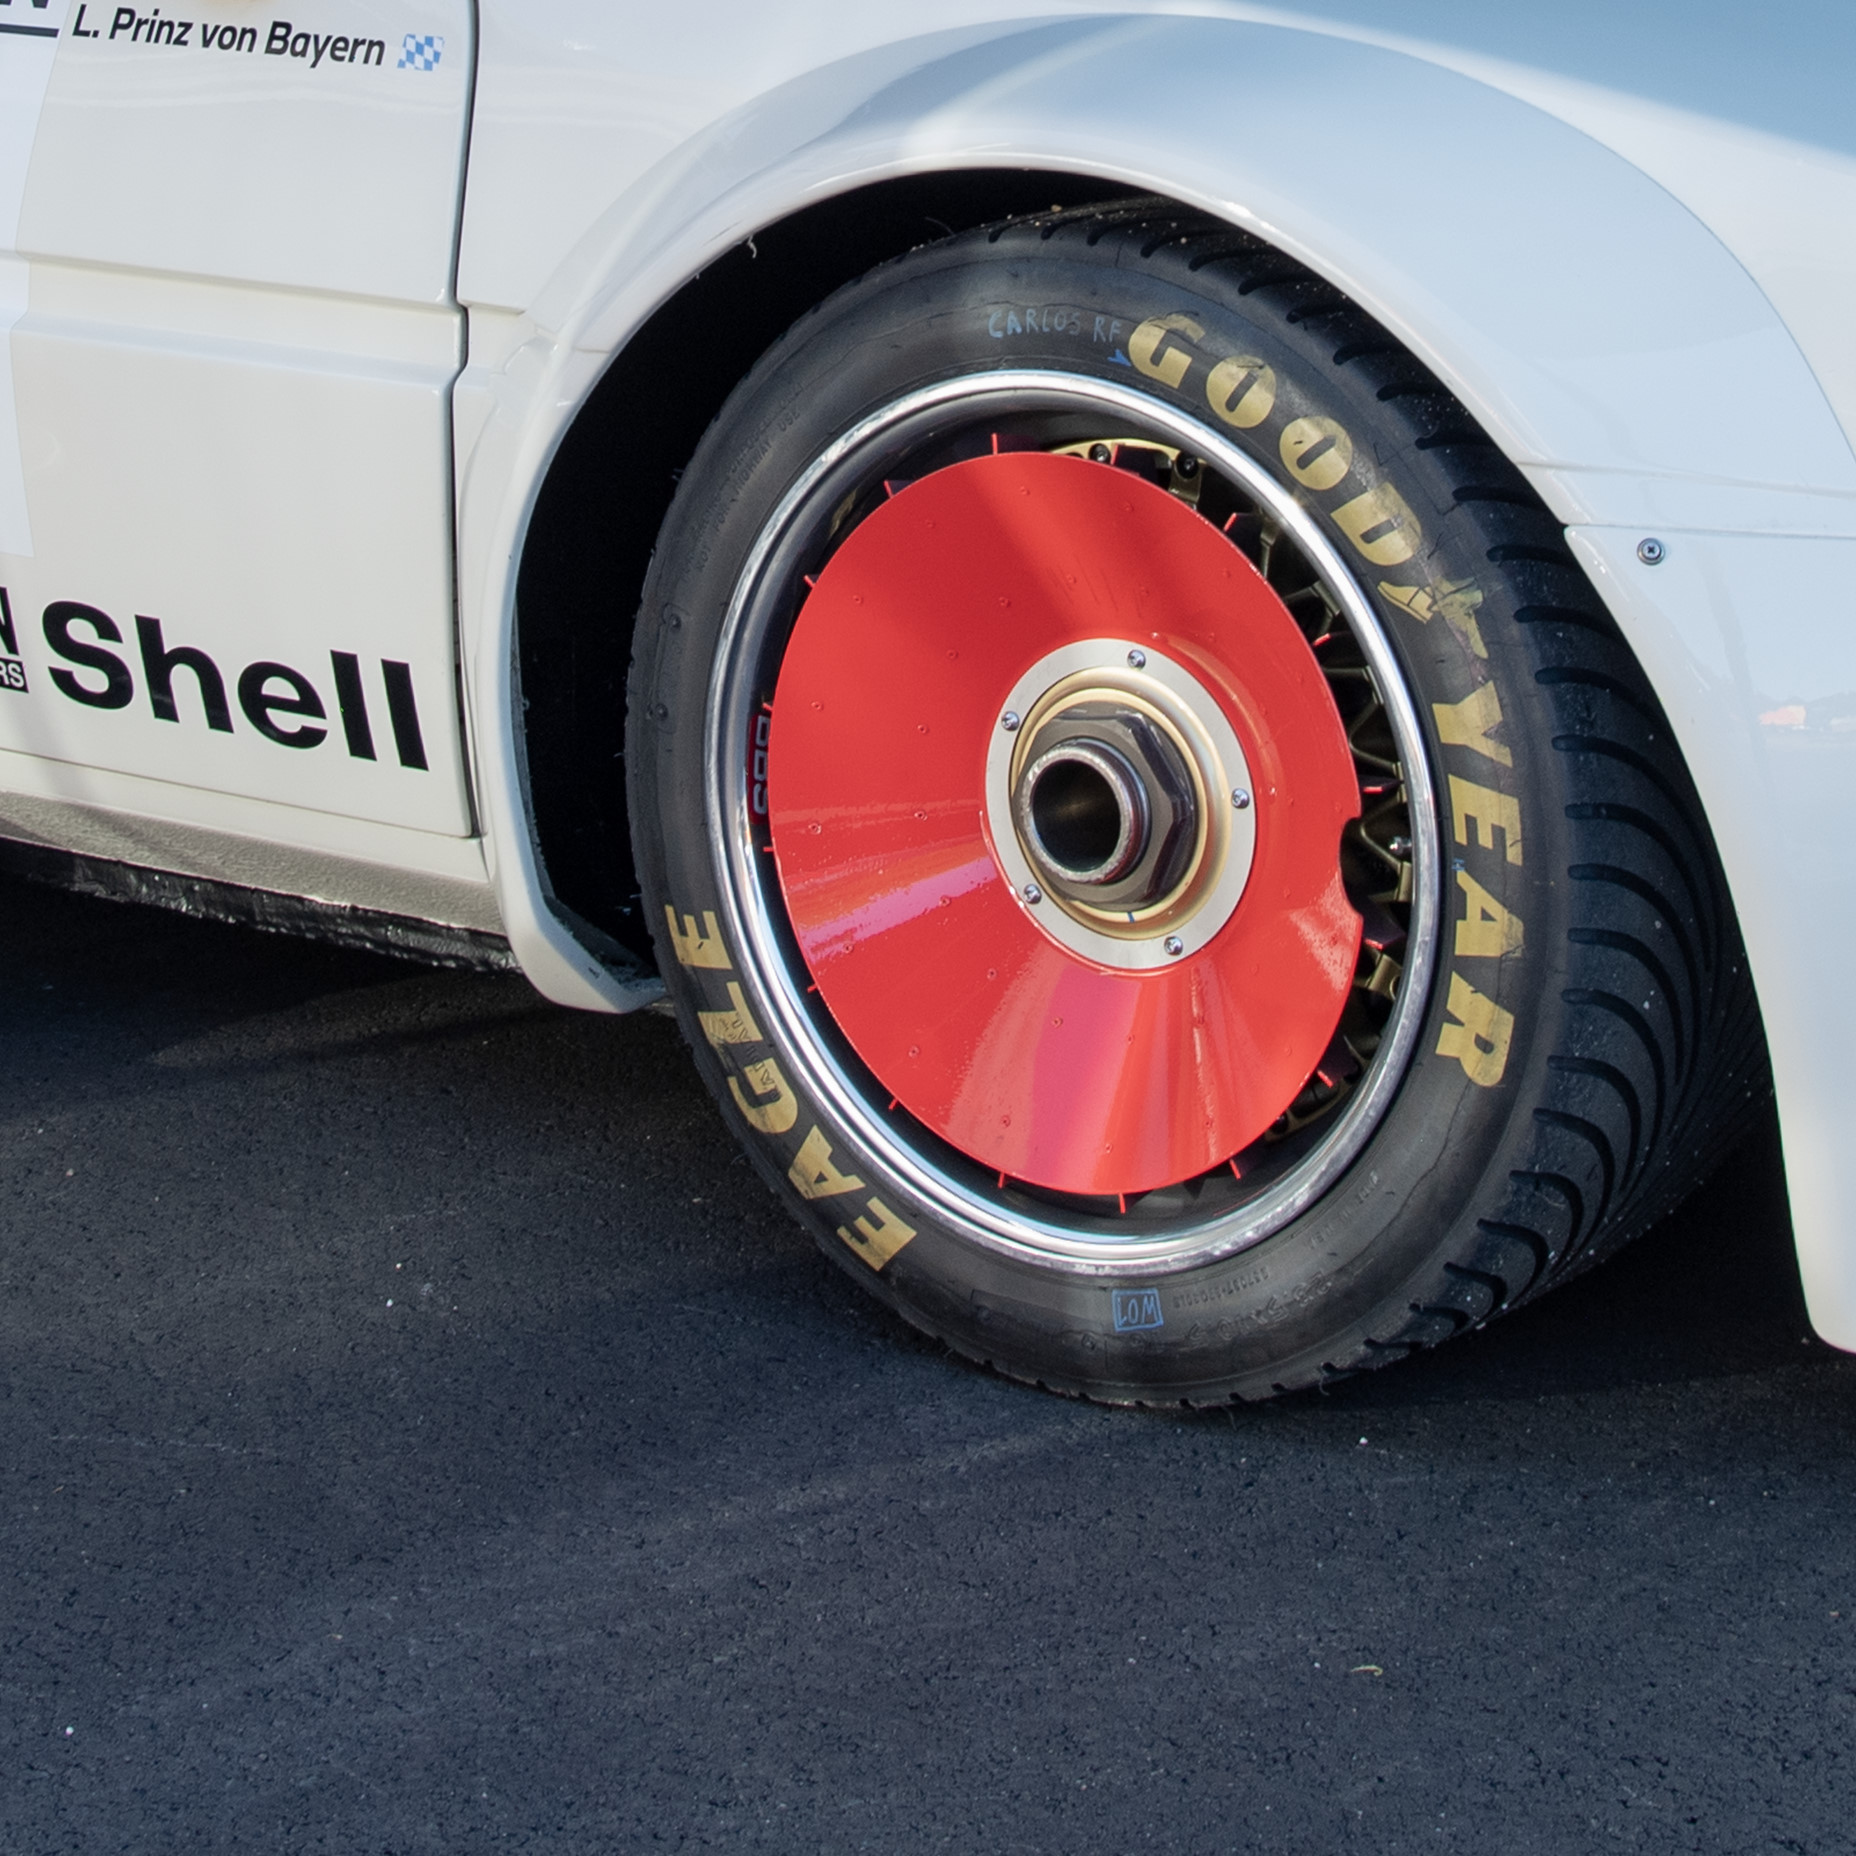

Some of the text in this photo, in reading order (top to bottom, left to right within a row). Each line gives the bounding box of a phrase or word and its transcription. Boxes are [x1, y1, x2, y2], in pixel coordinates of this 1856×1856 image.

[72, 4, 386, 69] L. Prinz von Bayern
[988, 308, 1123, 343] CARLOS RF
[41, 598, 430, 772] Shell
[664, 904, 918, 1272] EAGLE
